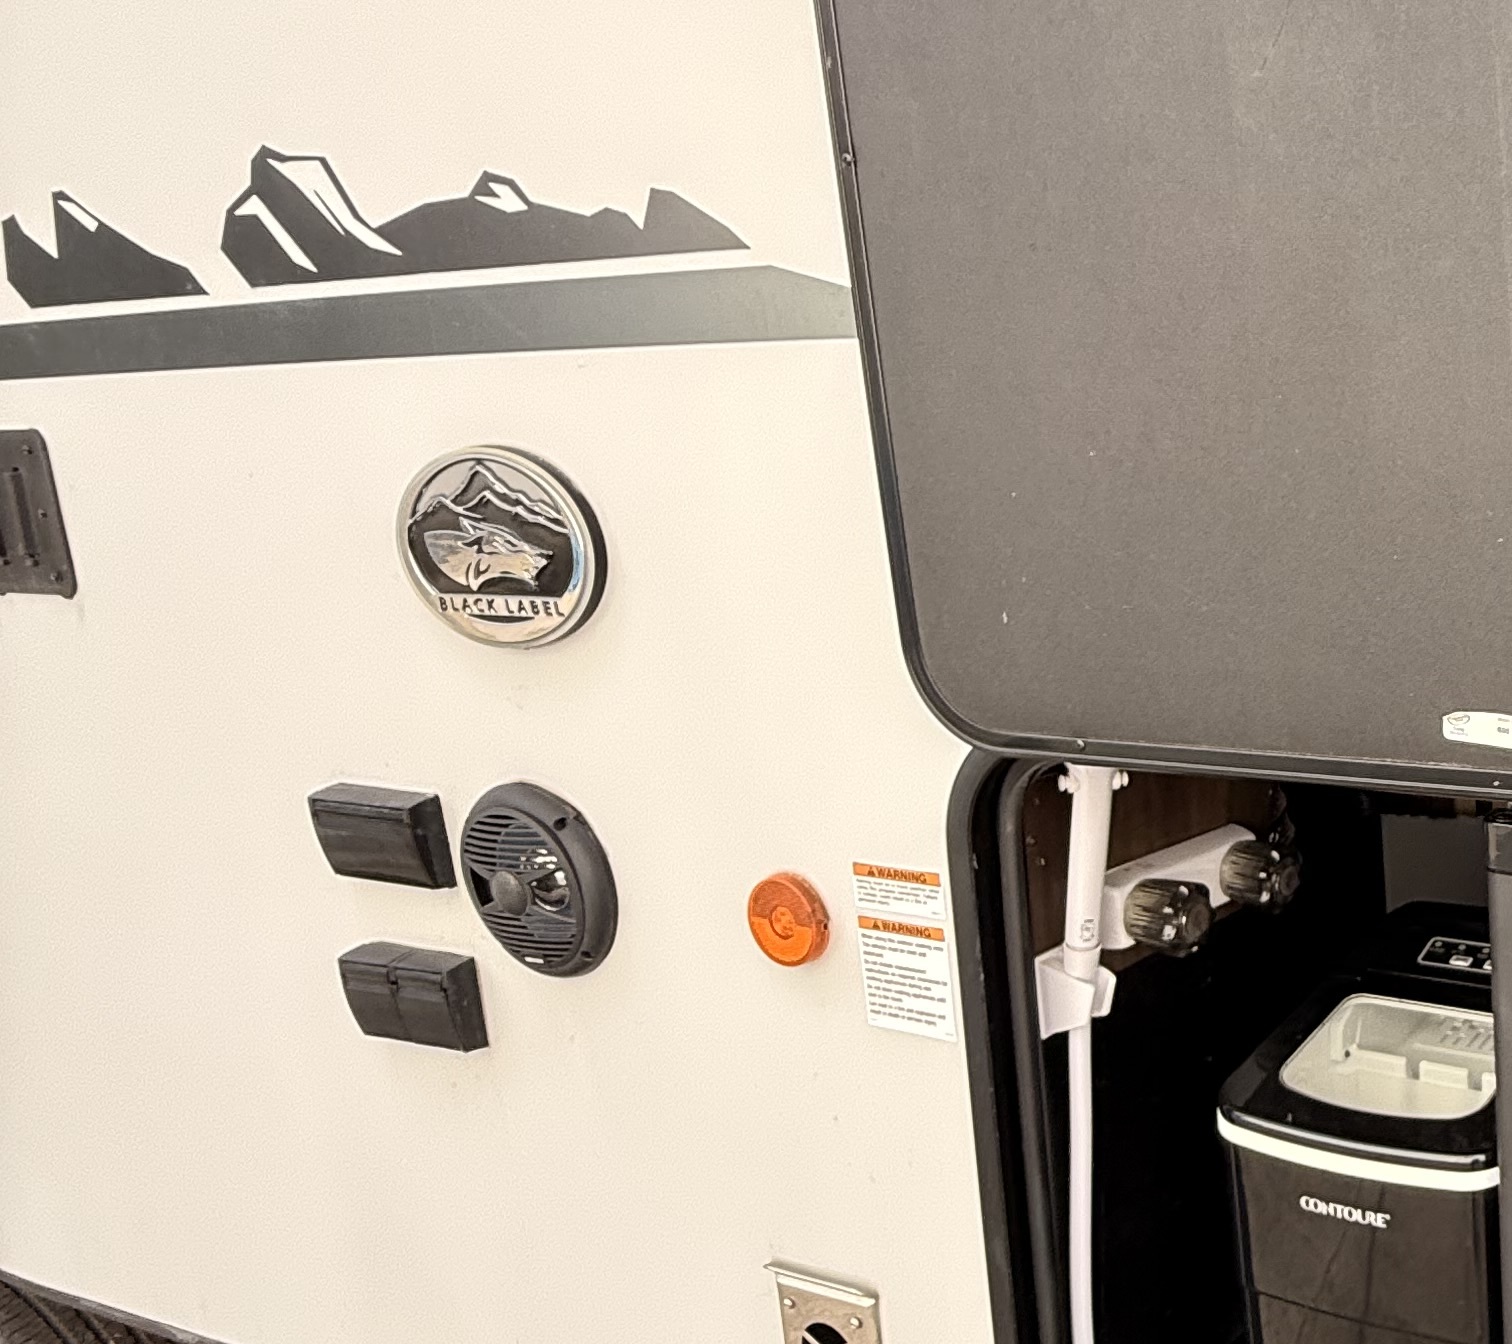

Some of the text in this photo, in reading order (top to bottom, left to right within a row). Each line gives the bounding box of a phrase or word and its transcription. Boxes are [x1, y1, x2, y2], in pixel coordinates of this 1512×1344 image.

[439, 596, 566, 618] BLACK LABEL
[877, 867, 927, 884] WARNING
[881, 920, 932, 938] WARNING
[1299, 1196, 1390, 1229] CONTOURE
